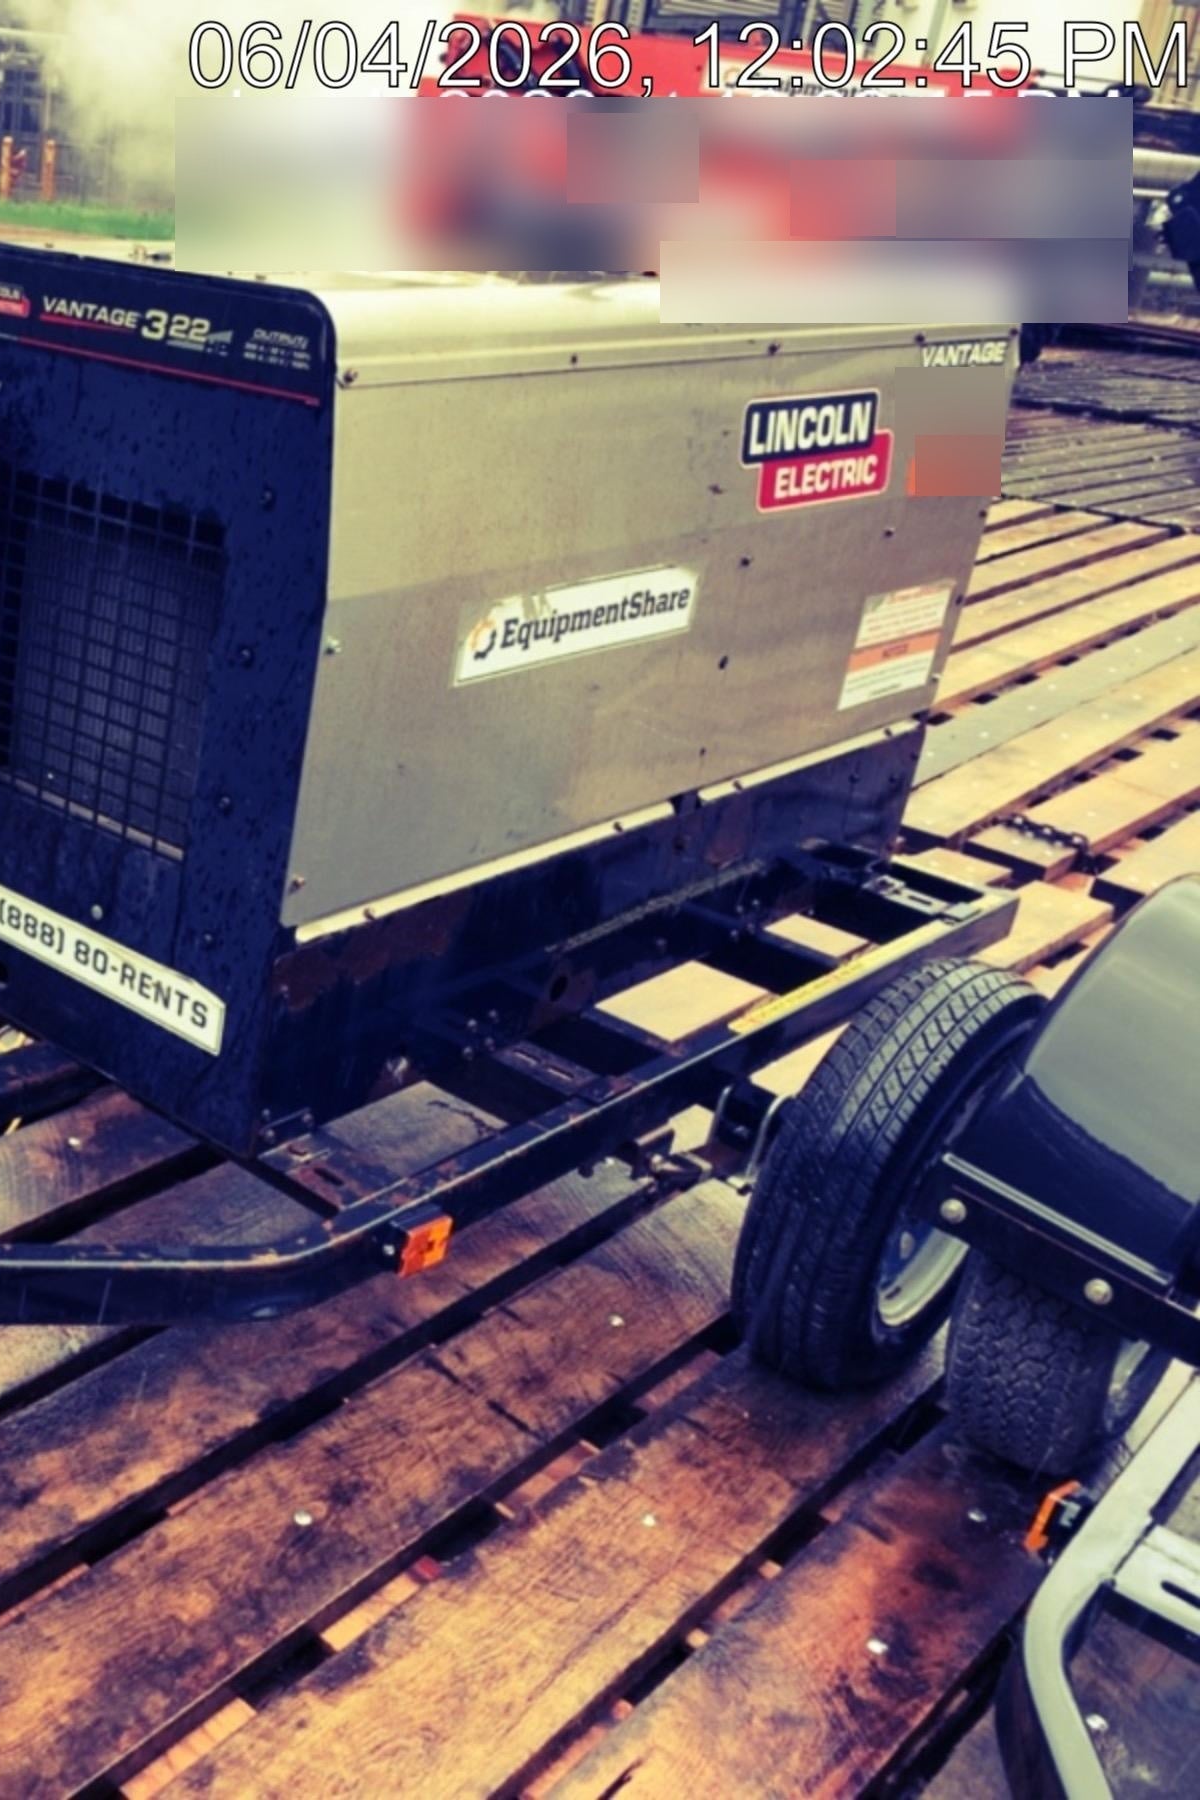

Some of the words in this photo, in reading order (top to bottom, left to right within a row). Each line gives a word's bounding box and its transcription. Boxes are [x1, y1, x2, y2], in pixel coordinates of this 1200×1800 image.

[42, 295, 141, 330] VANTAGE
[141, 309, 211, 343] 322
[921, 341, 1008, 368] VANTAGE
[749, 401, 872, 456] LINCOLN
[773, 455, 879, 500] ELECTRIC
[500, 587, 691, 651] EquipmentShare
